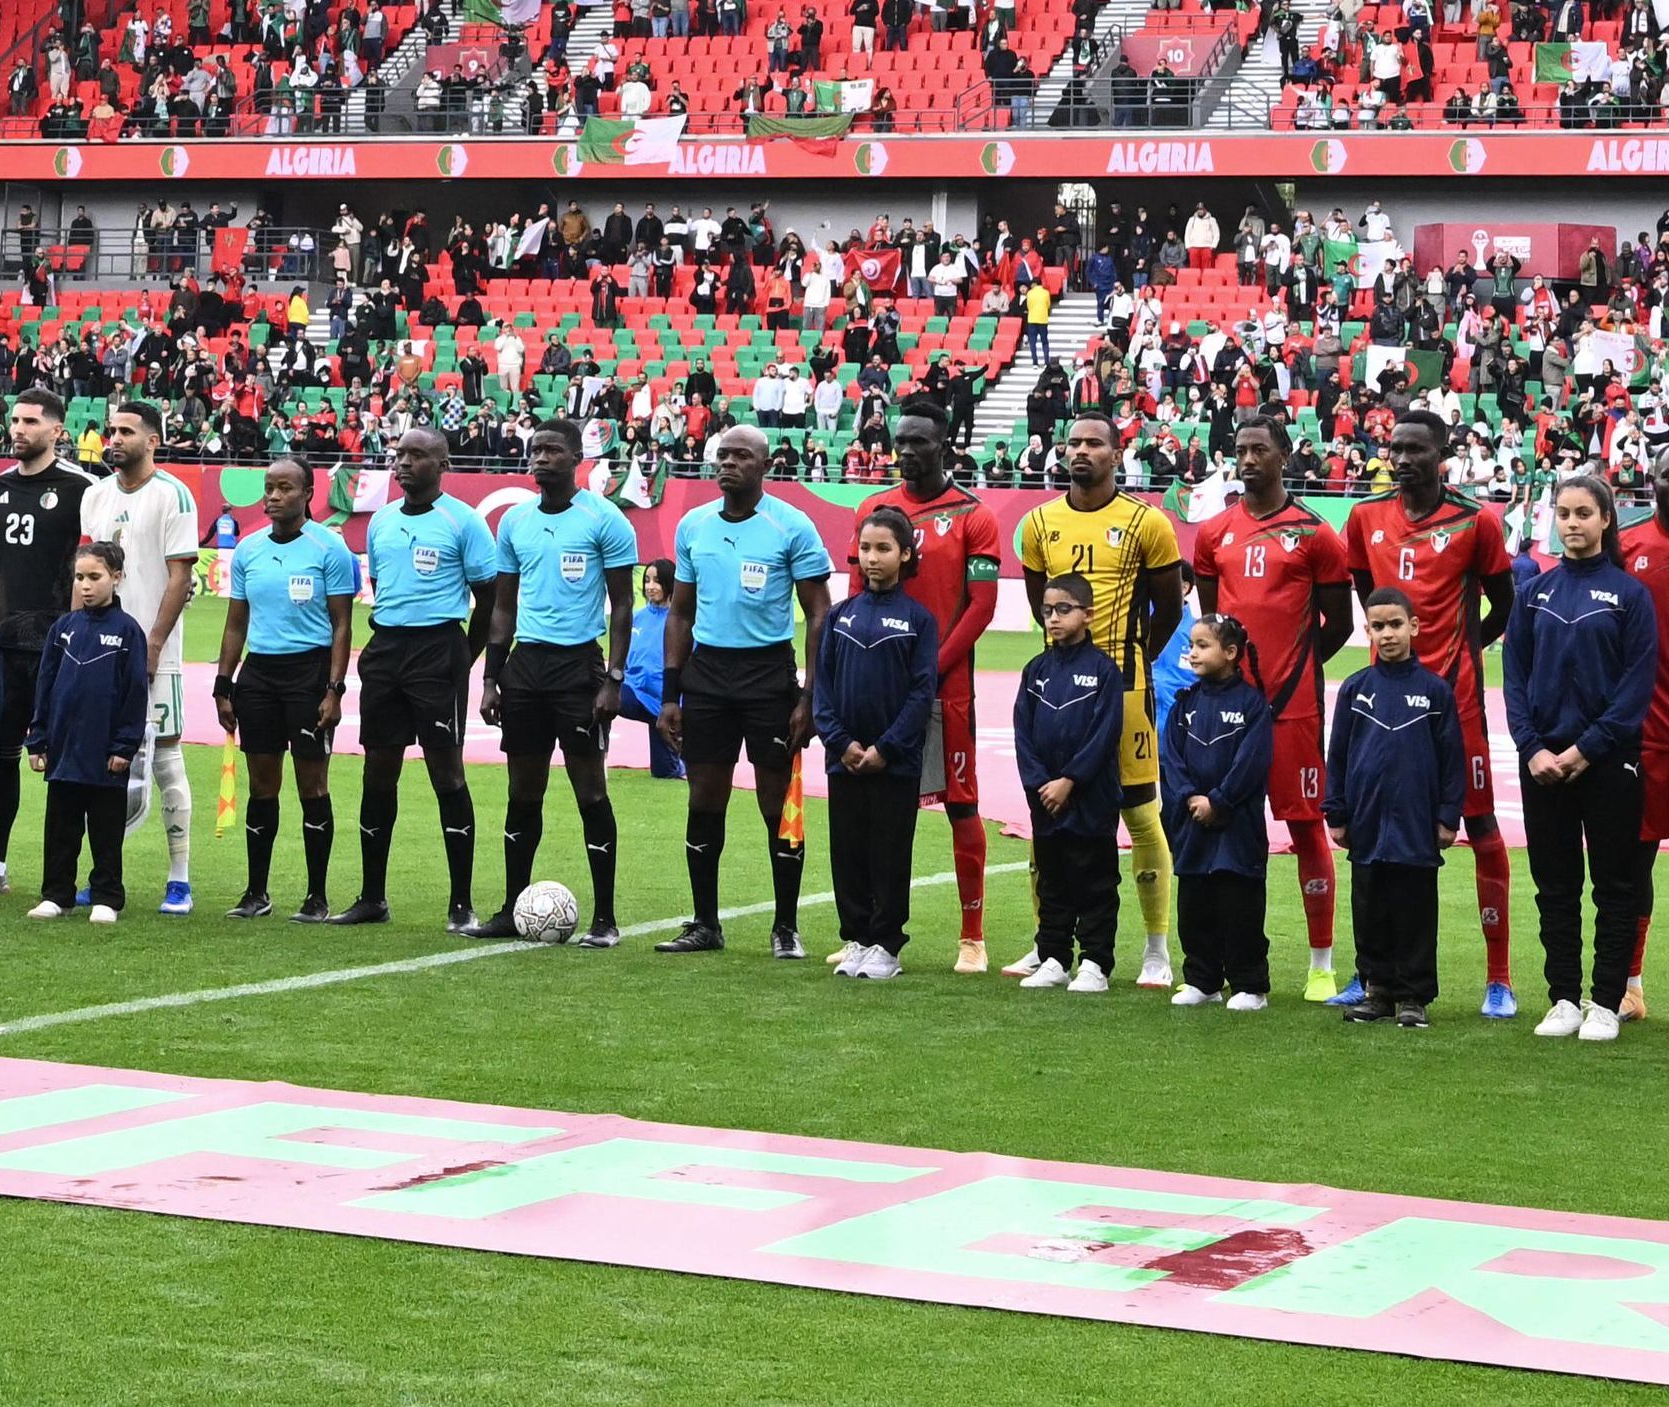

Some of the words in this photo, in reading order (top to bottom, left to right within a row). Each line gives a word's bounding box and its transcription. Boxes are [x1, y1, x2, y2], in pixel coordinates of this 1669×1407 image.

[1167, 49, 1184, 62] 10
[468, 59, 478, 71] 9
[265, 147, 357, 175] ALGERIA
[668, 144, 767, 174] ALGERIA
[1106, 142, 1214, 172] ALGERIA
[5, 513, 35, 546] 23
[415, 548, 437, 558] FIFA
[562, 556, 584, 564] FIFA
[1072, 544, 1095, 574] 21
[743, 565, 765, 574] FIFA
[1244, 545, 1267, 578] 13
[1399, 548, 1415, 581] 6
[291, 578, 311, 586] FIFA
[1590, 590, 1618, 606] VISA
[881, 618, 910, 632] VISA
[100, 634, 123, 647] VISA
[1073, 675, 1098, 687] VISA
[1220, 711, 1245, 724] VISA
[1134, 731, 1152, 759] 21
[1472, 755, 1485, 790] 6
[1299, 766, 1320, 798] 13
